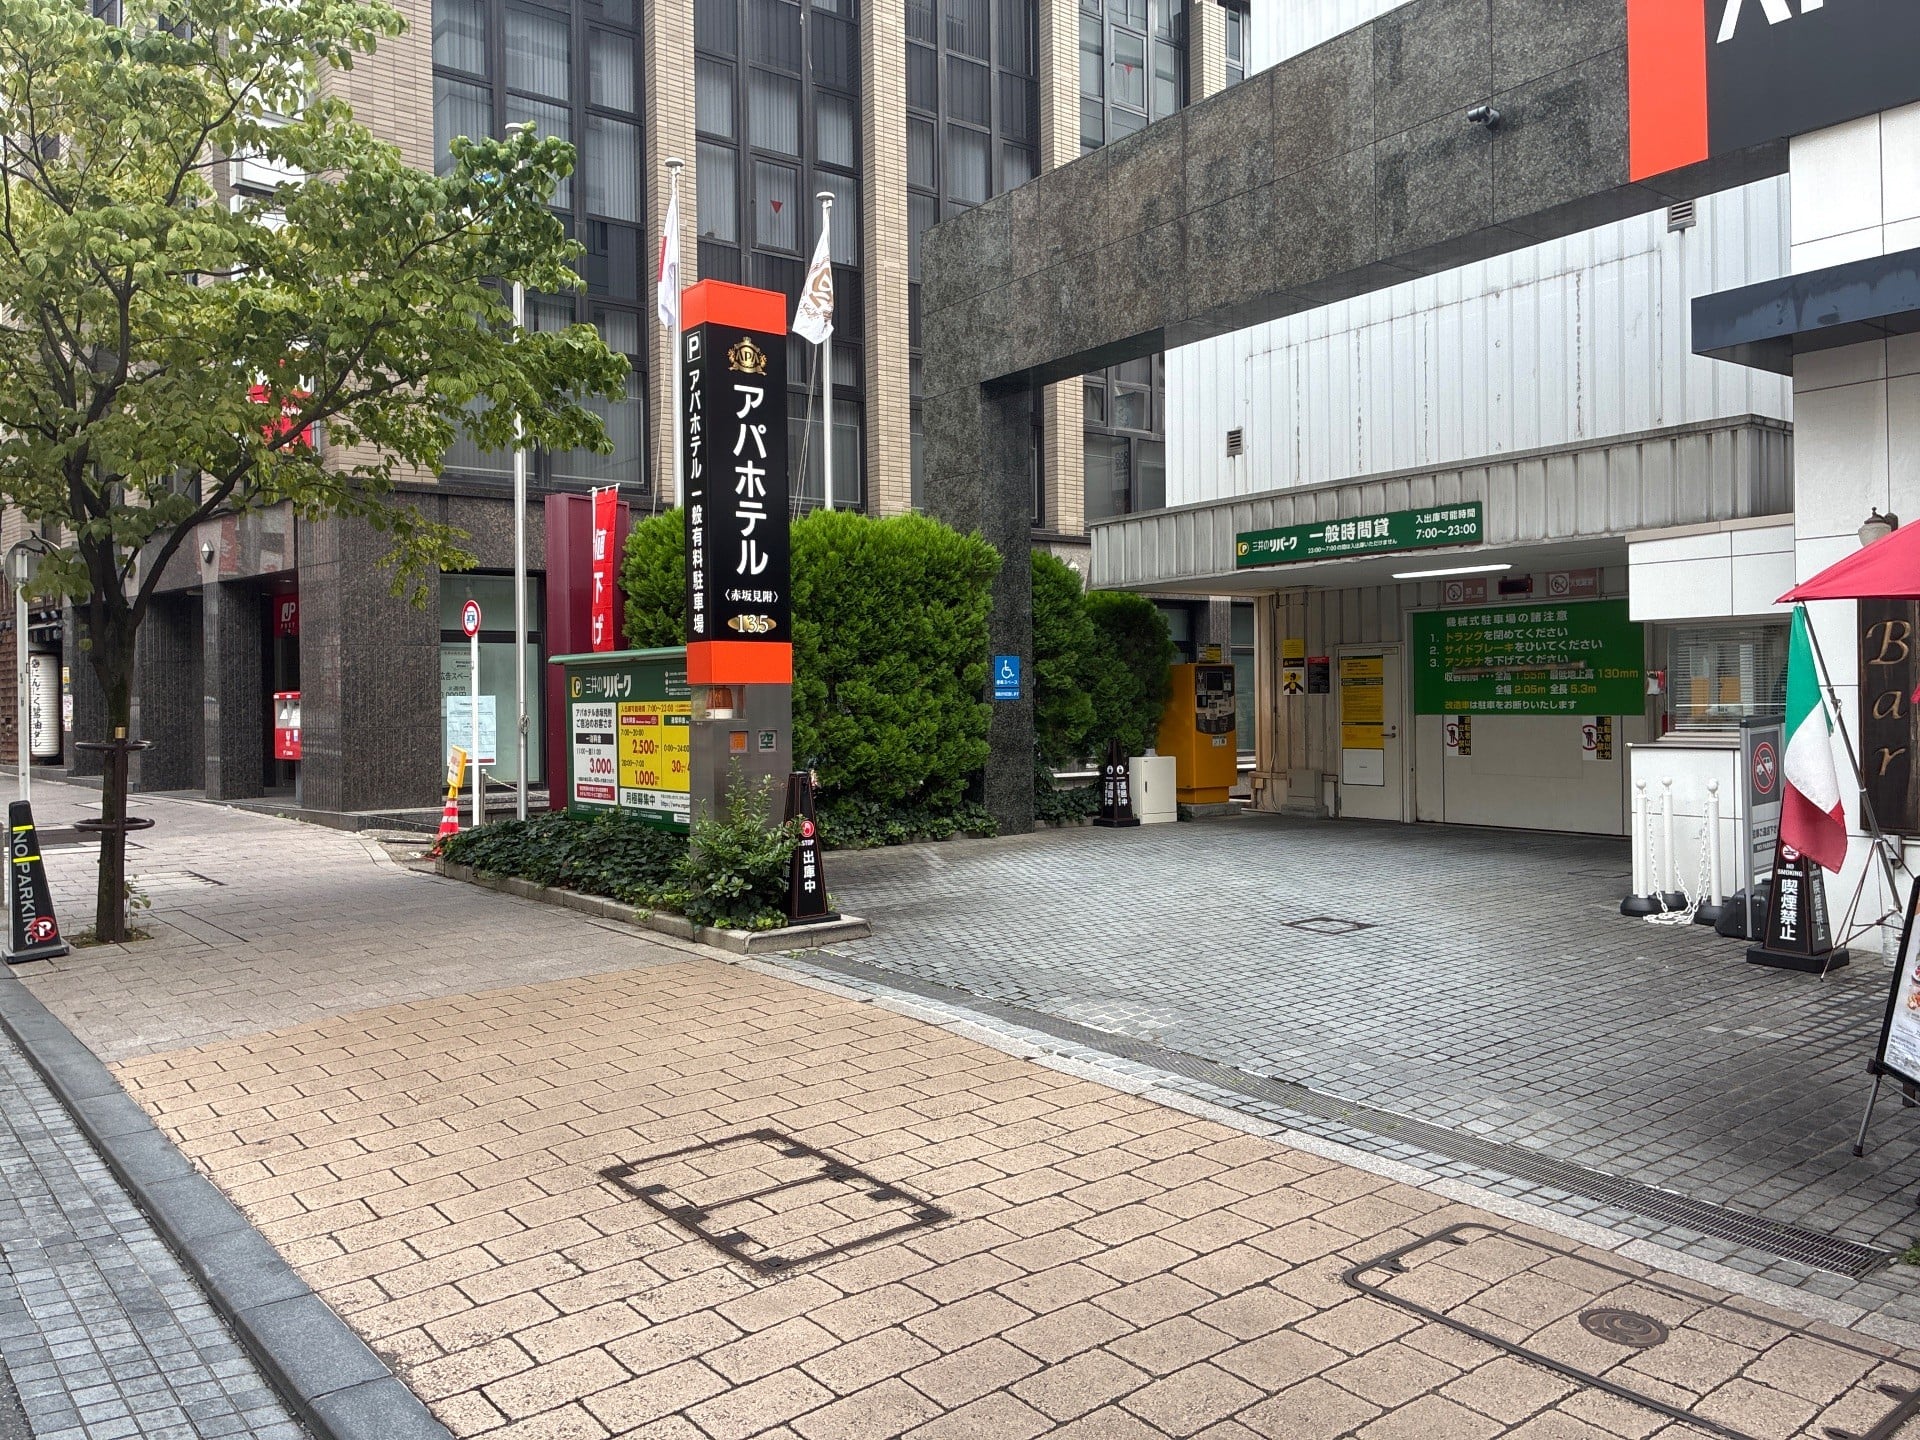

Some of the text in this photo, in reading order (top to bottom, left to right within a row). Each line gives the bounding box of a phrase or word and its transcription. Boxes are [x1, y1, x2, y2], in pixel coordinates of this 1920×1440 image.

[733, 384, 768, 575] アパホテル
[689, 369, 704, 634] アパホテル 一般有料駐車場
[1416, 508, 1476, 524] 入出庫可能時間
[1309, 518, 1389, 544] 一般時間貸
[1252, 537, 1297, 553] 三井のリパーク
[737, 614, 769, 633] 135
[1446, 610, 1568, 627] 機械式駐車場の諸注意
[1446, 627, 1569, 642] トランクを閉めてください
[1445, 639, 1603, 653] サイドブレーキをひいてください
[1598, 668, 1639, 679] 130mm
[585, 673, 632, 698] 三井のリパーク
[1514, 684, 1546, 694] 2.05m
[1550, 684, 1568, 694] 全長
[1570, 684, 1597, 694] 5.3m
[1866, 619, 1912, 777] Bar
[760, 733, 774, 749] 空
[12, 831, 28, 857] NO
[803, 850, 816, 893] 出庫中
[1777, 869, 1803, 877] SMOKING
[16, 862, 39, 946] PARKING
[1779, 879, 1798, 942] 喫煙禁止
